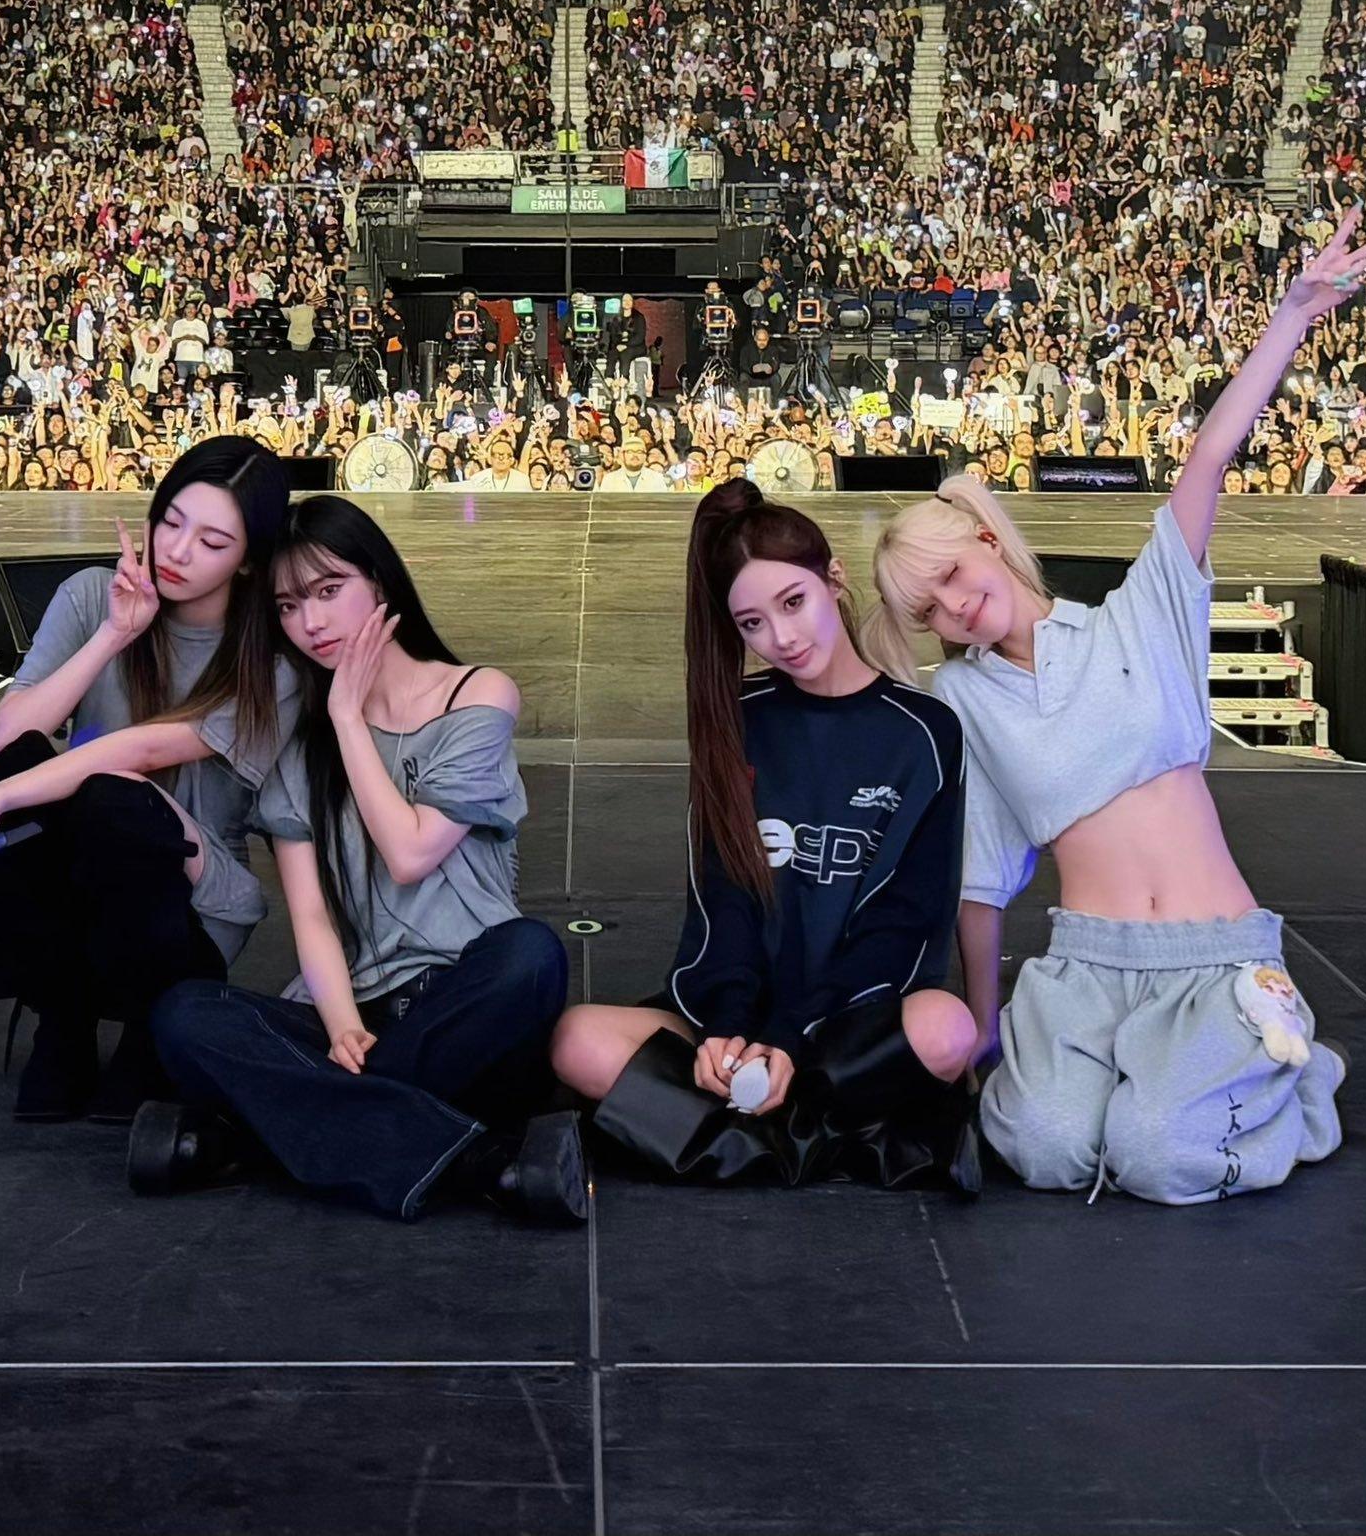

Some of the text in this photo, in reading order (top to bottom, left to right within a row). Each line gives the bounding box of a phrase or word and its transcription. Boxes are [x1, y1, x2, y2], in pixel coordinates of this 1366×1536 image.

[537, 189, 599, 200] SALIA DE
[530, 200, 606, 211] EMERENCIA
